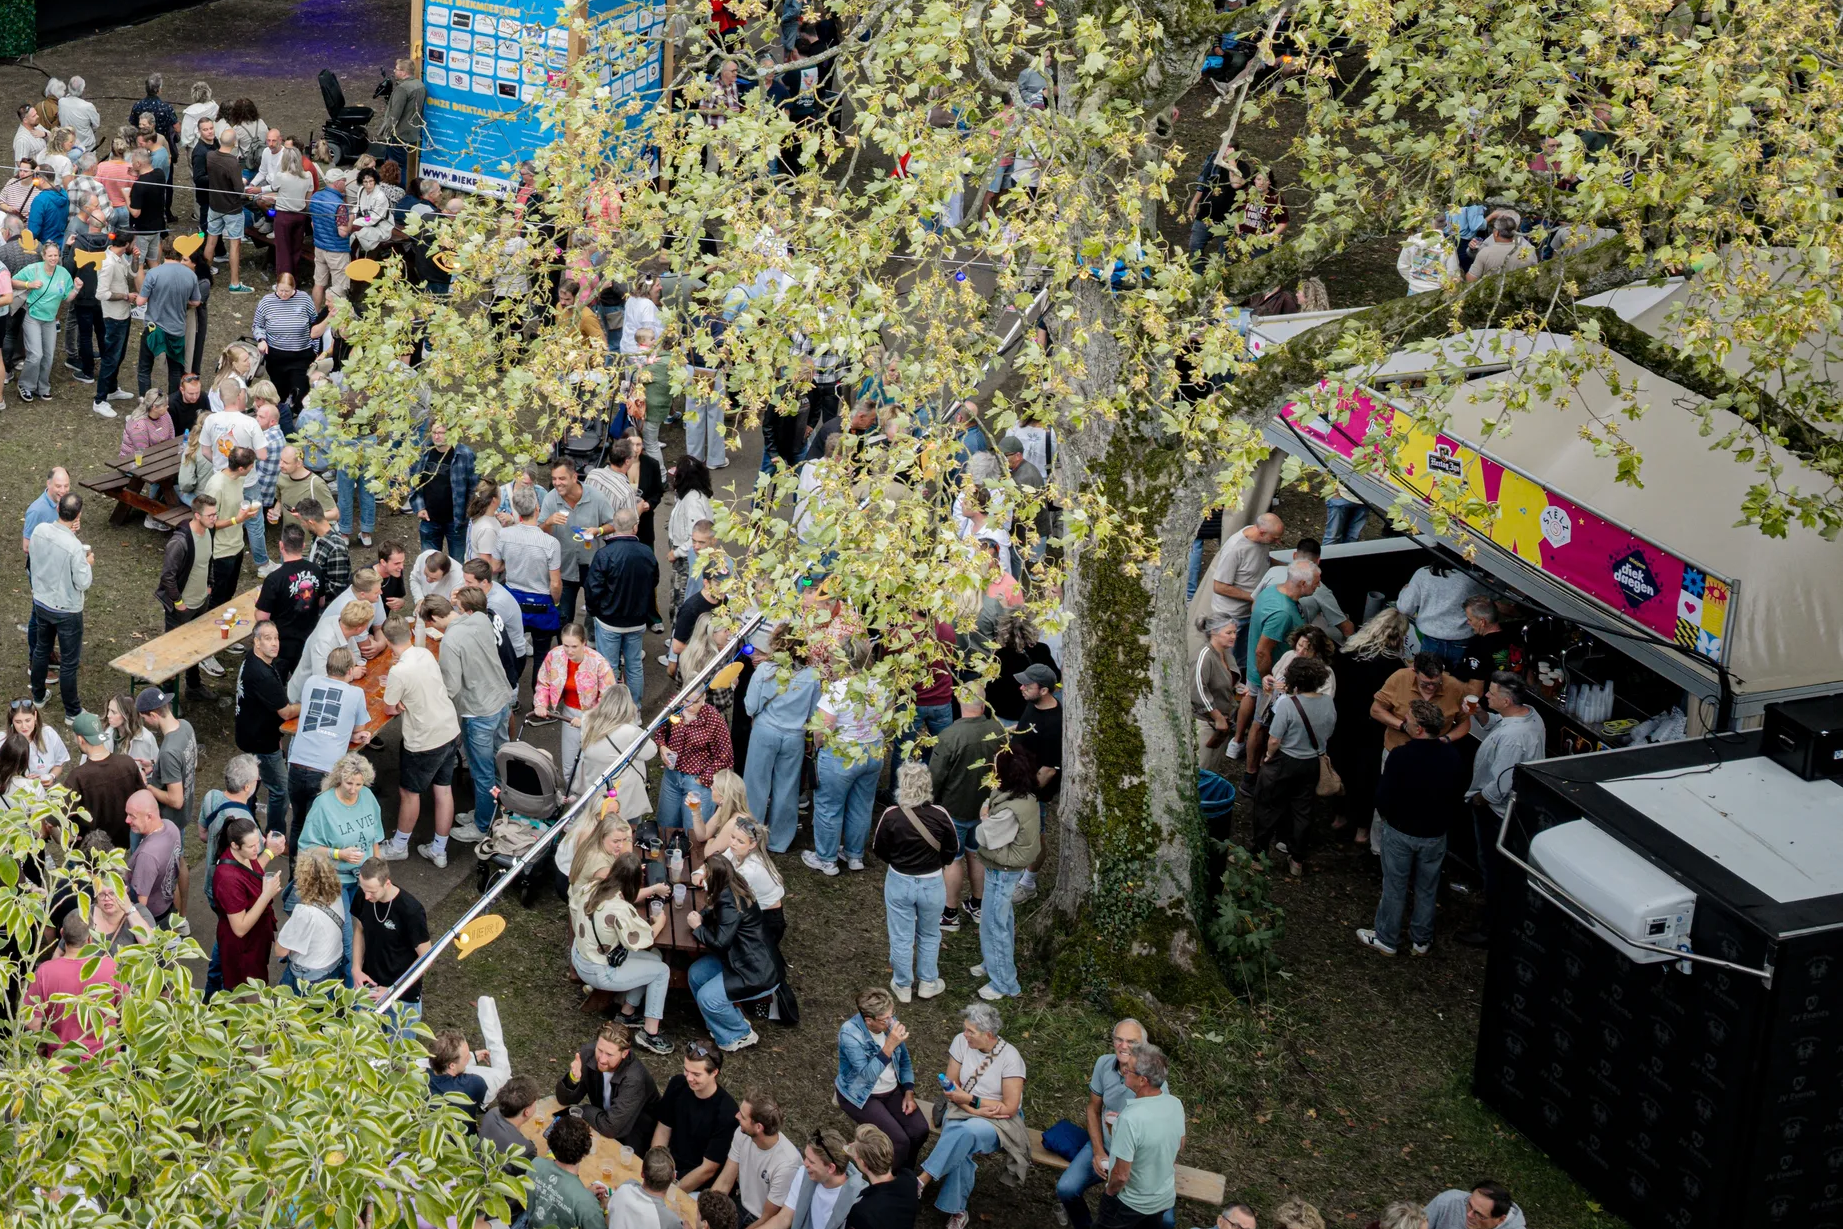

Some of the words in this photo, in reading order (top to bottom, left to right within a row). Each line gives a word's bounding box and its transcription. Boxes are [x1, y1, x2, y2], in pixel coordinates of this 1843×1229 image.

[426, 96, 450, 109] ONZE
[1613, 569, 1654, 596] daegen
[1621, 562, 1645, 583] diek
[338, 821, 355, 836] LA
[355, 813, 375, 829] VIE
[358, 831, 366, 843] A
